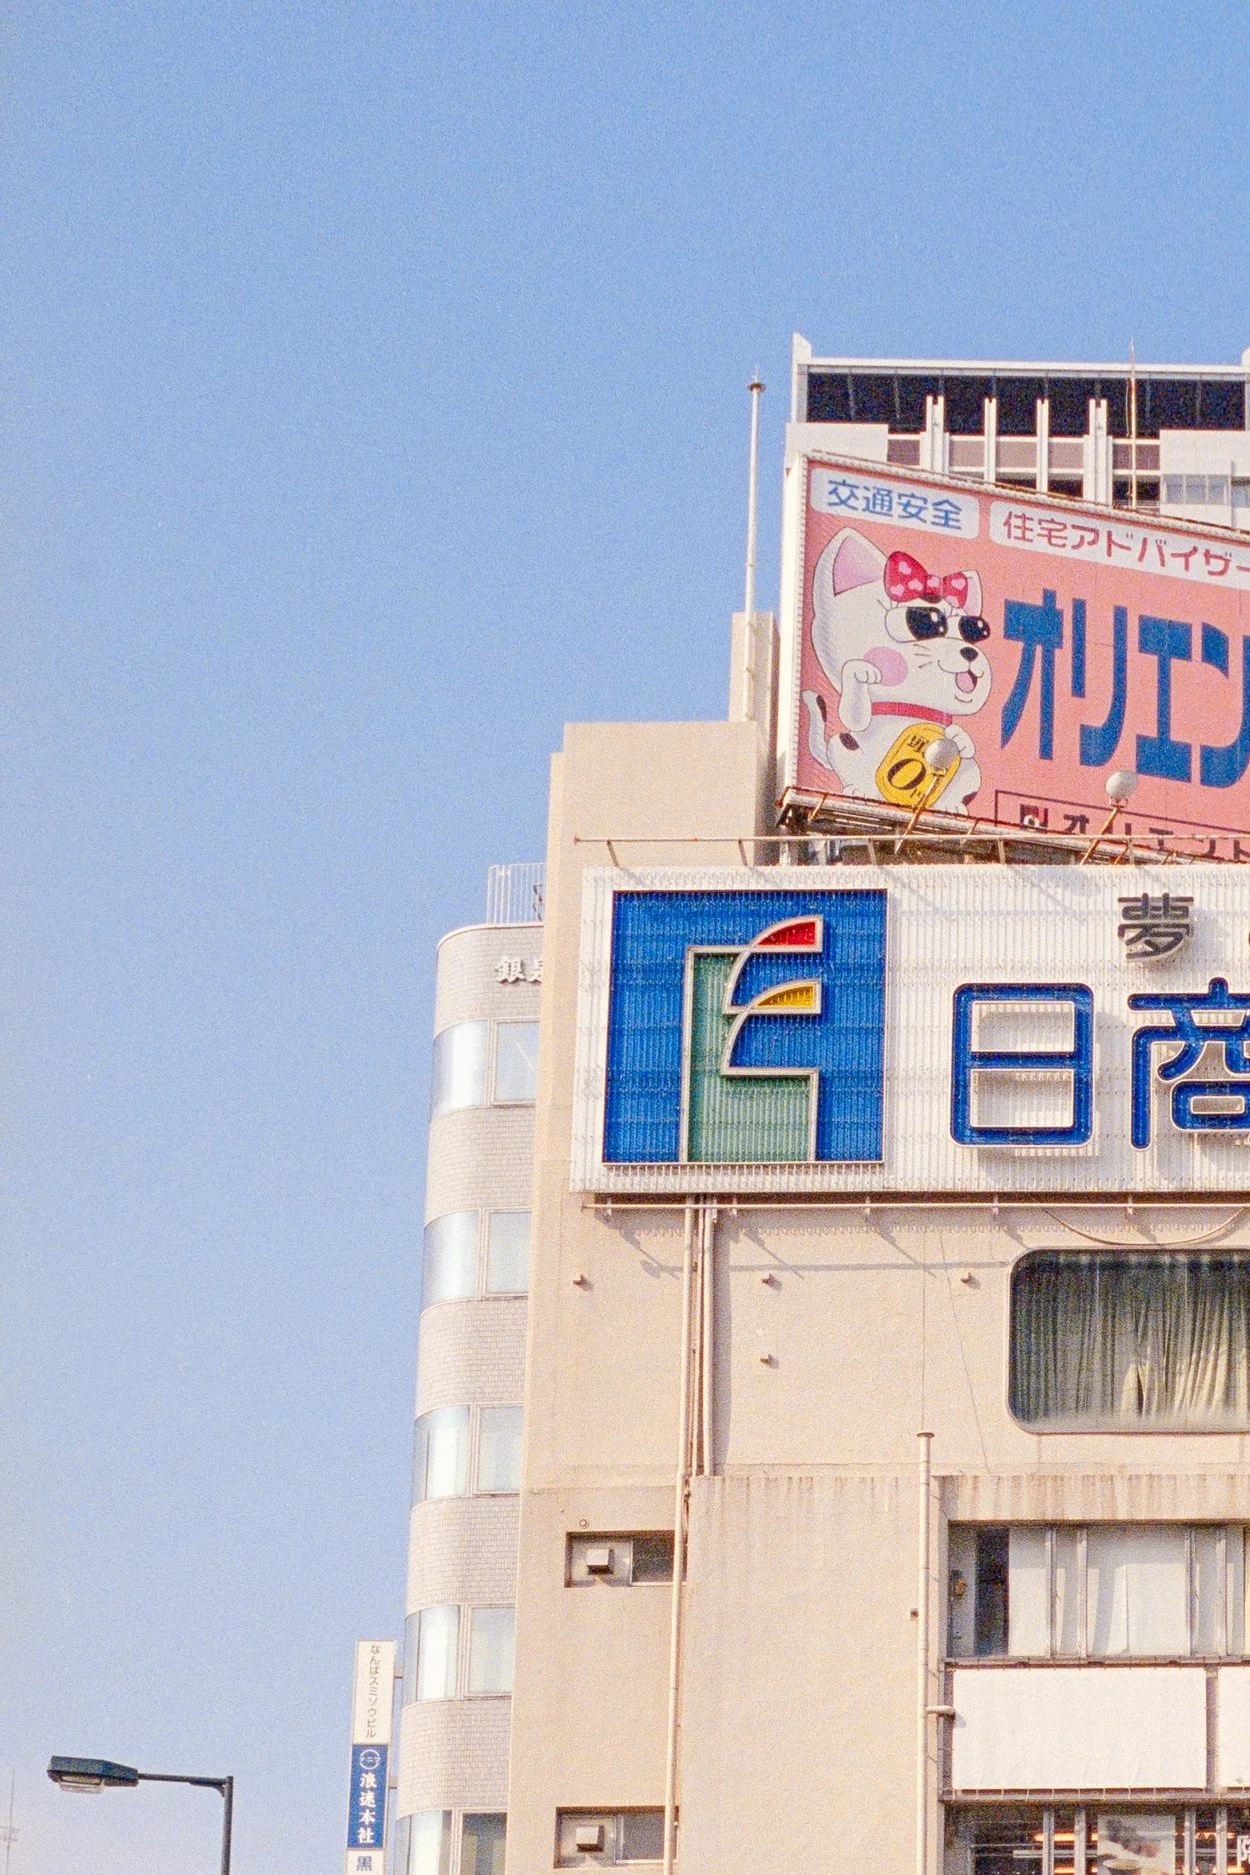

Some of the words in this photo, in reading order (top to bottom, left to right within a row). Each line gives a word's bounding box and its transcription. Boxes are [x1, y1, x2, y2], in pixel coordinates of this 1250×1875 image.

[827, 476, 963, 532] 交通安全
[365, 1645, 381, 1739] なんばスミソウビル
[358, 1772, 377, 1844] 浪速本社
